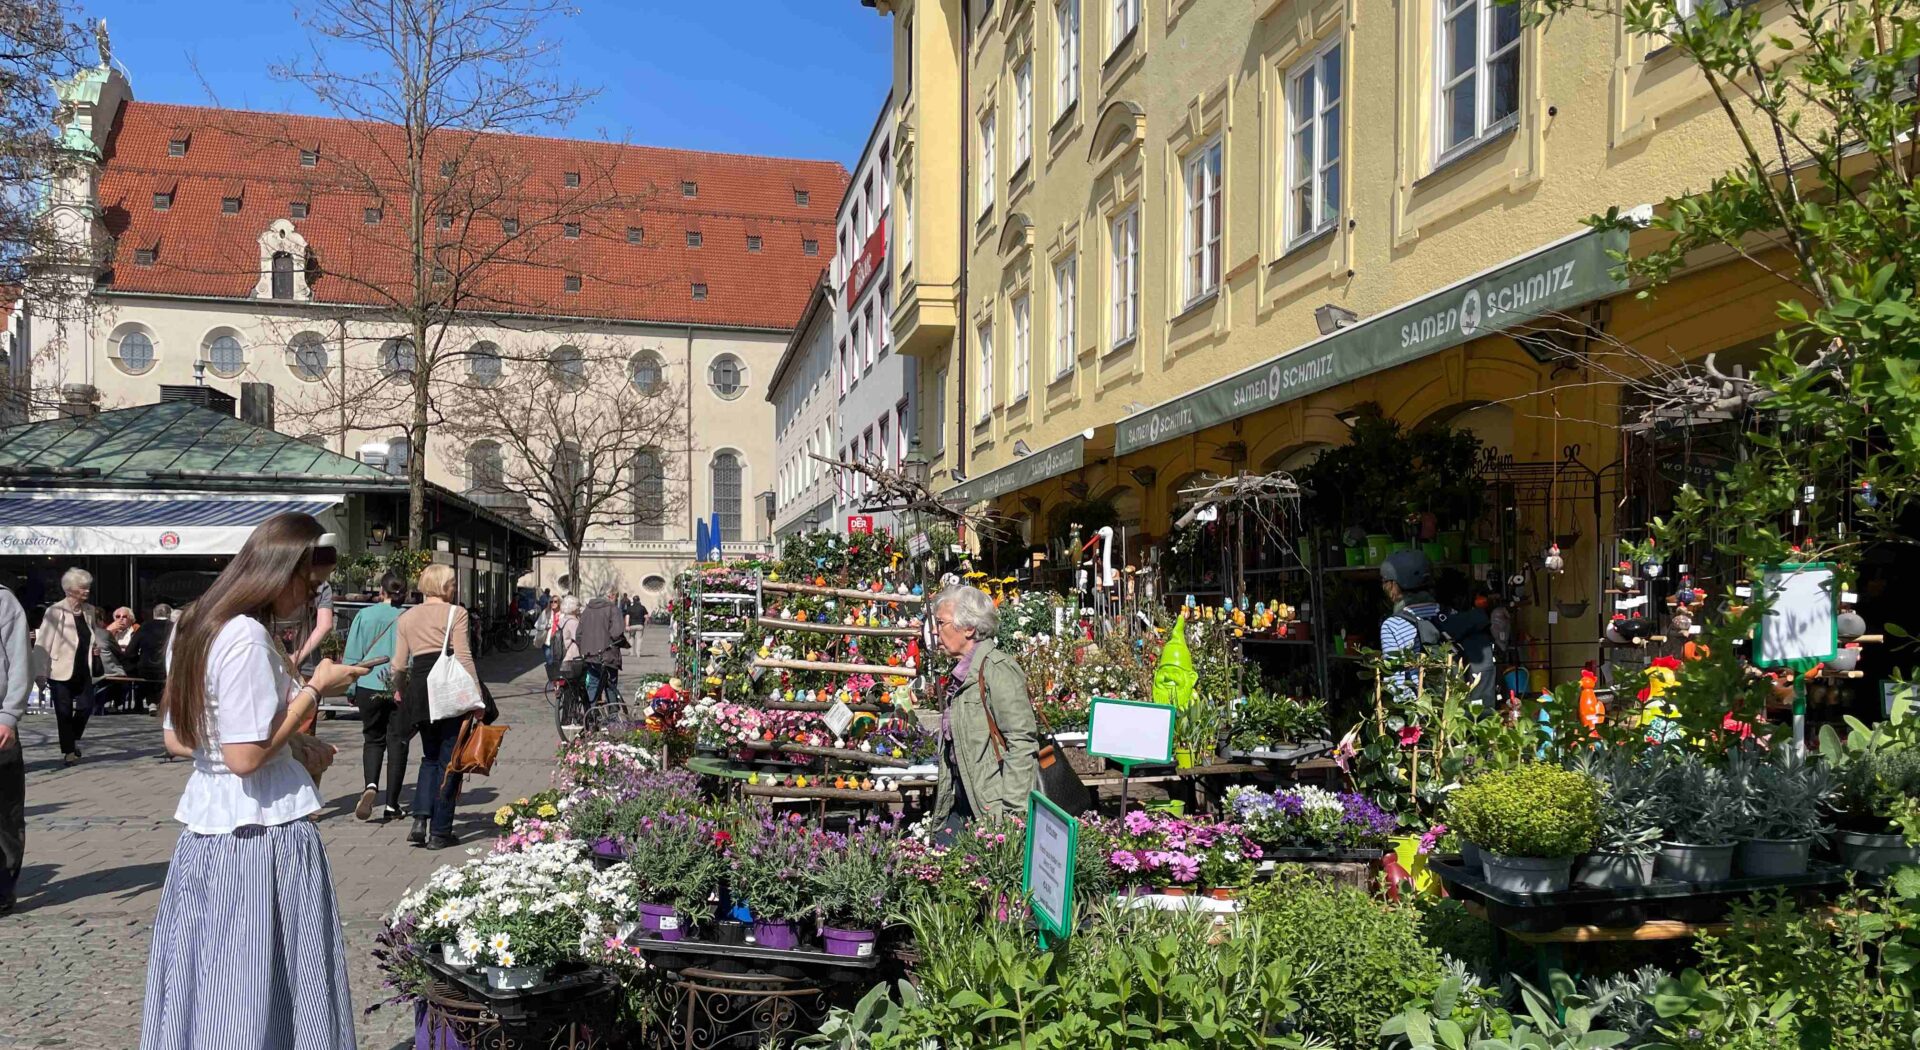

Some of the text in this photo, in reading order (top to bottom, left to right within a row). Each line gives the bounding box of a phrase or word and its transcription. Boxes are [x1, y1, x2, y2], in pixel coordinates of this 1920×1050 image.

[1401, 259, 1576, 348] SAMEN SCHMITZ
[1233, 353, 1334, 406] SAMEN SCHMITZ
[1160, 408, 1193, 432] SCHMITZ
[851, 519, 868, 528] DER
